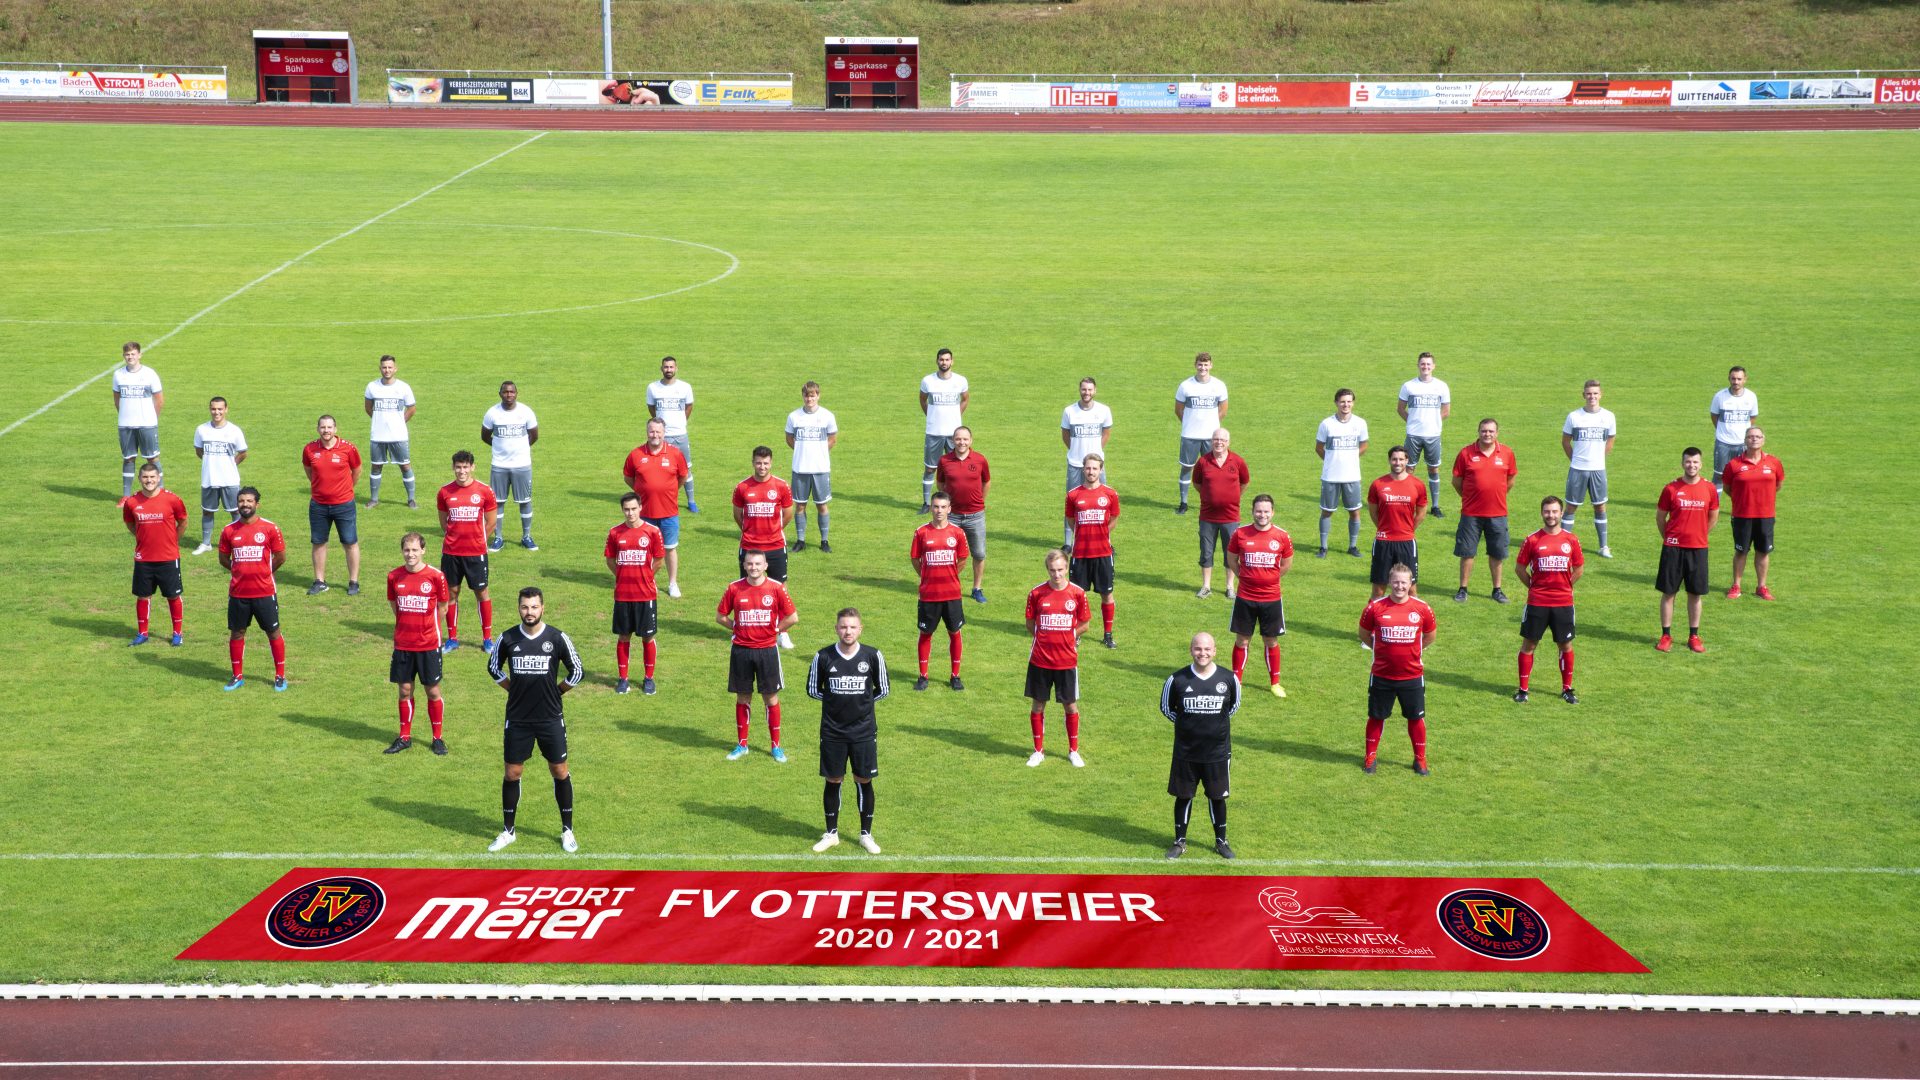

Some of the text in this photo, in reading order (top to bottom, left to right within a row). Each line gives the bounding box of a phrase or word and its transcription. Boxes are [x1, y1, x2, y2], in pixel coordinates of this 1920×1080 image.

[284, 56, 324, 65] Sparkasse
[849, 62, 888, 70] Sparkasse
[286, 65, 304, 73] Bühl
[849, 71, 868, 79] Bühl
[63, 78, 140, 88] Baden STROM
[148, 80, 214, 89] Baden GAS
[723, 89, 756, 99] Falk
[1238, 86, 1277, 94] Dabeisein
[1238, 94, 1281, 102] ist einfach.
[1678, 93, 1737, 101] WITTENAUER
[512, 657, 549, 669] Meier
[829, 677, 866, 690] Meier
[1183, 697, 1223, 709] Meier
[498, 886, 635, 906] SPORT
[300, 886, 368, 922] FV
[659, 889, 1165, 922] FV OTTERSWEIER
[282, 893, 330, 938] OTTERSWEIER
[394, 897, 624, 940] Meier
[1458, 899, 1517, 936] FV
[1452, 907, 1525, 951] OTTERSWEIER
[815, 928, 999, 950] 2020 / 2021
